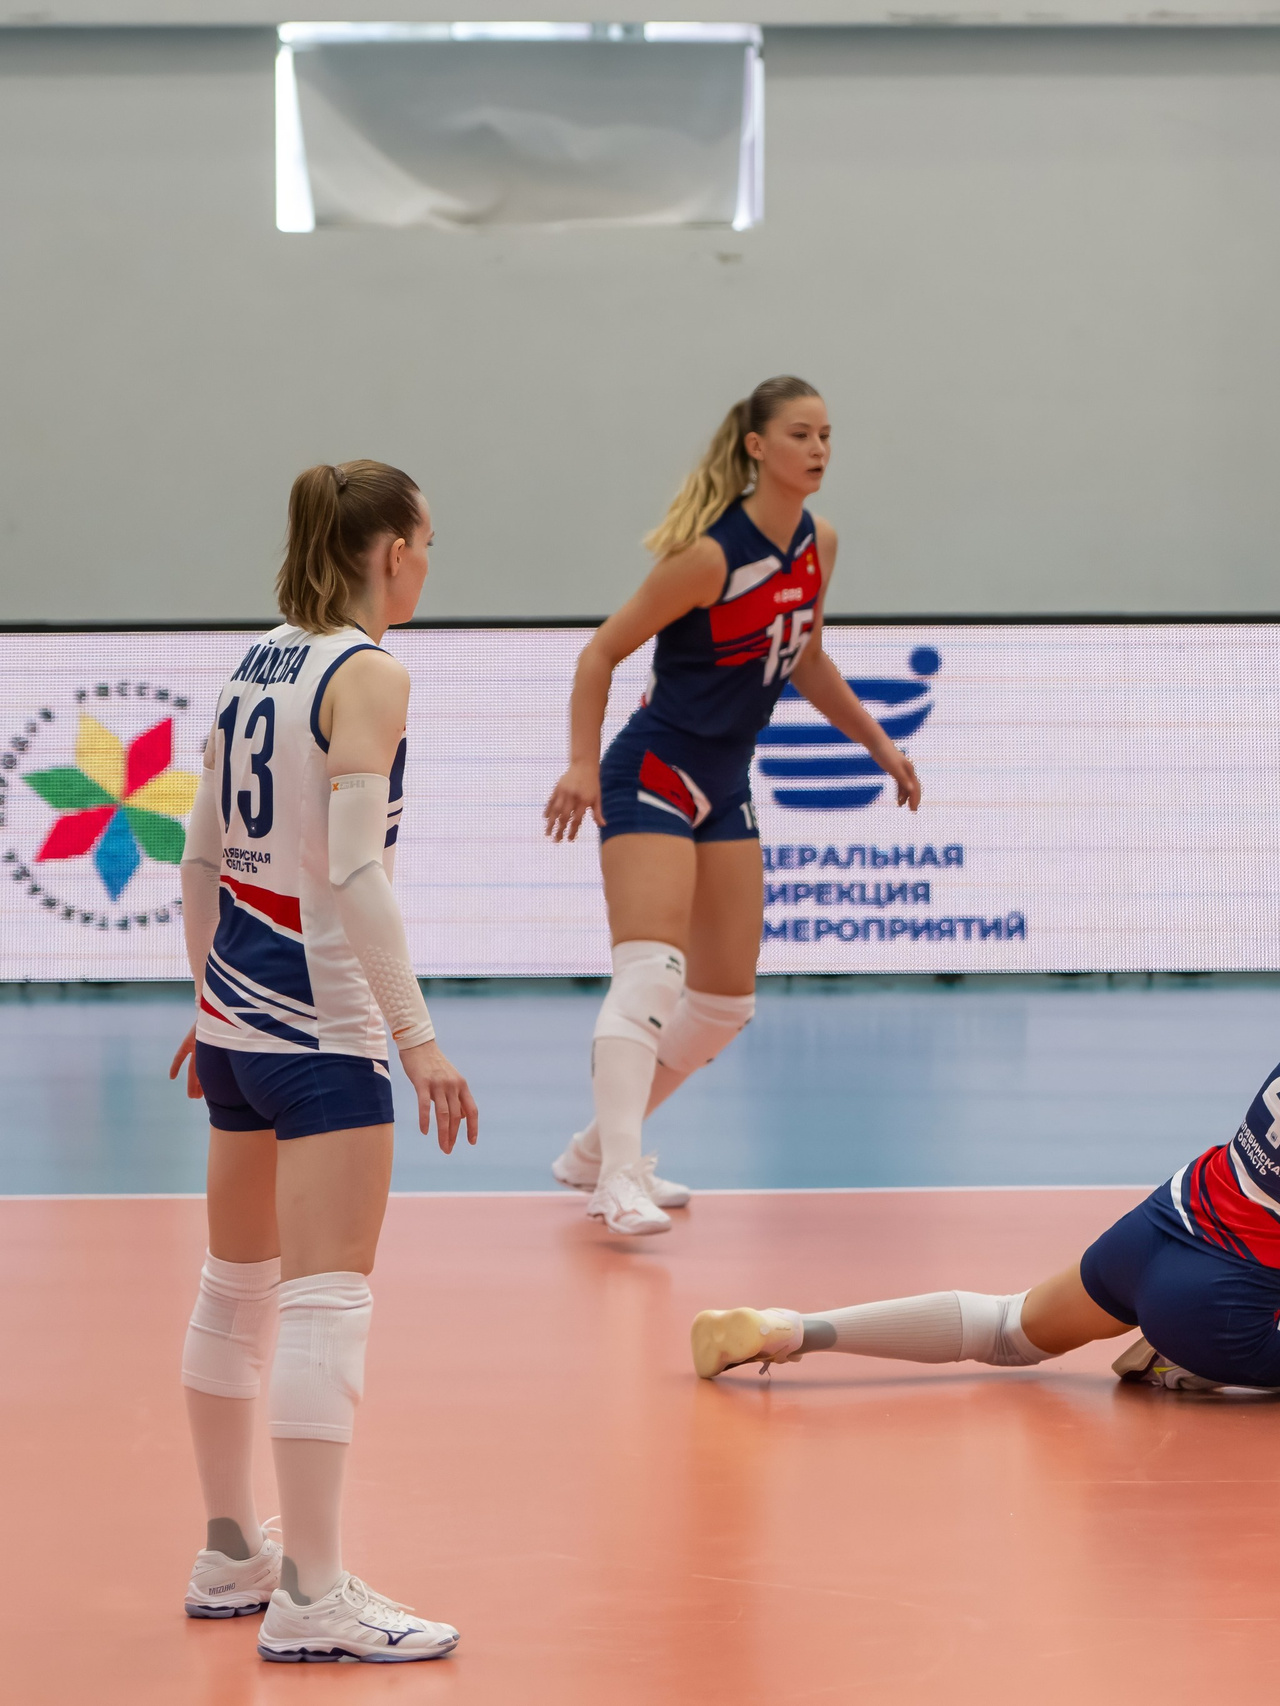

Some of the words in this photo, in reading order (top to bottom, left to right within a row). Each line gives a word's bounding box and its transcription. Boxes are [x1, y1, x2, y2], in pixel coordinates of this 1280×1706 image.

[230, 638, 311, 691] АЙЦЕВА
[761, 608, 814, 688] 15
[218, 696, 275, 838] 13
[763, 880, 930, 907] ИРЕКЦИЯ
[1237, 1131, 1267, 1176] ОБЛАСТЬ
